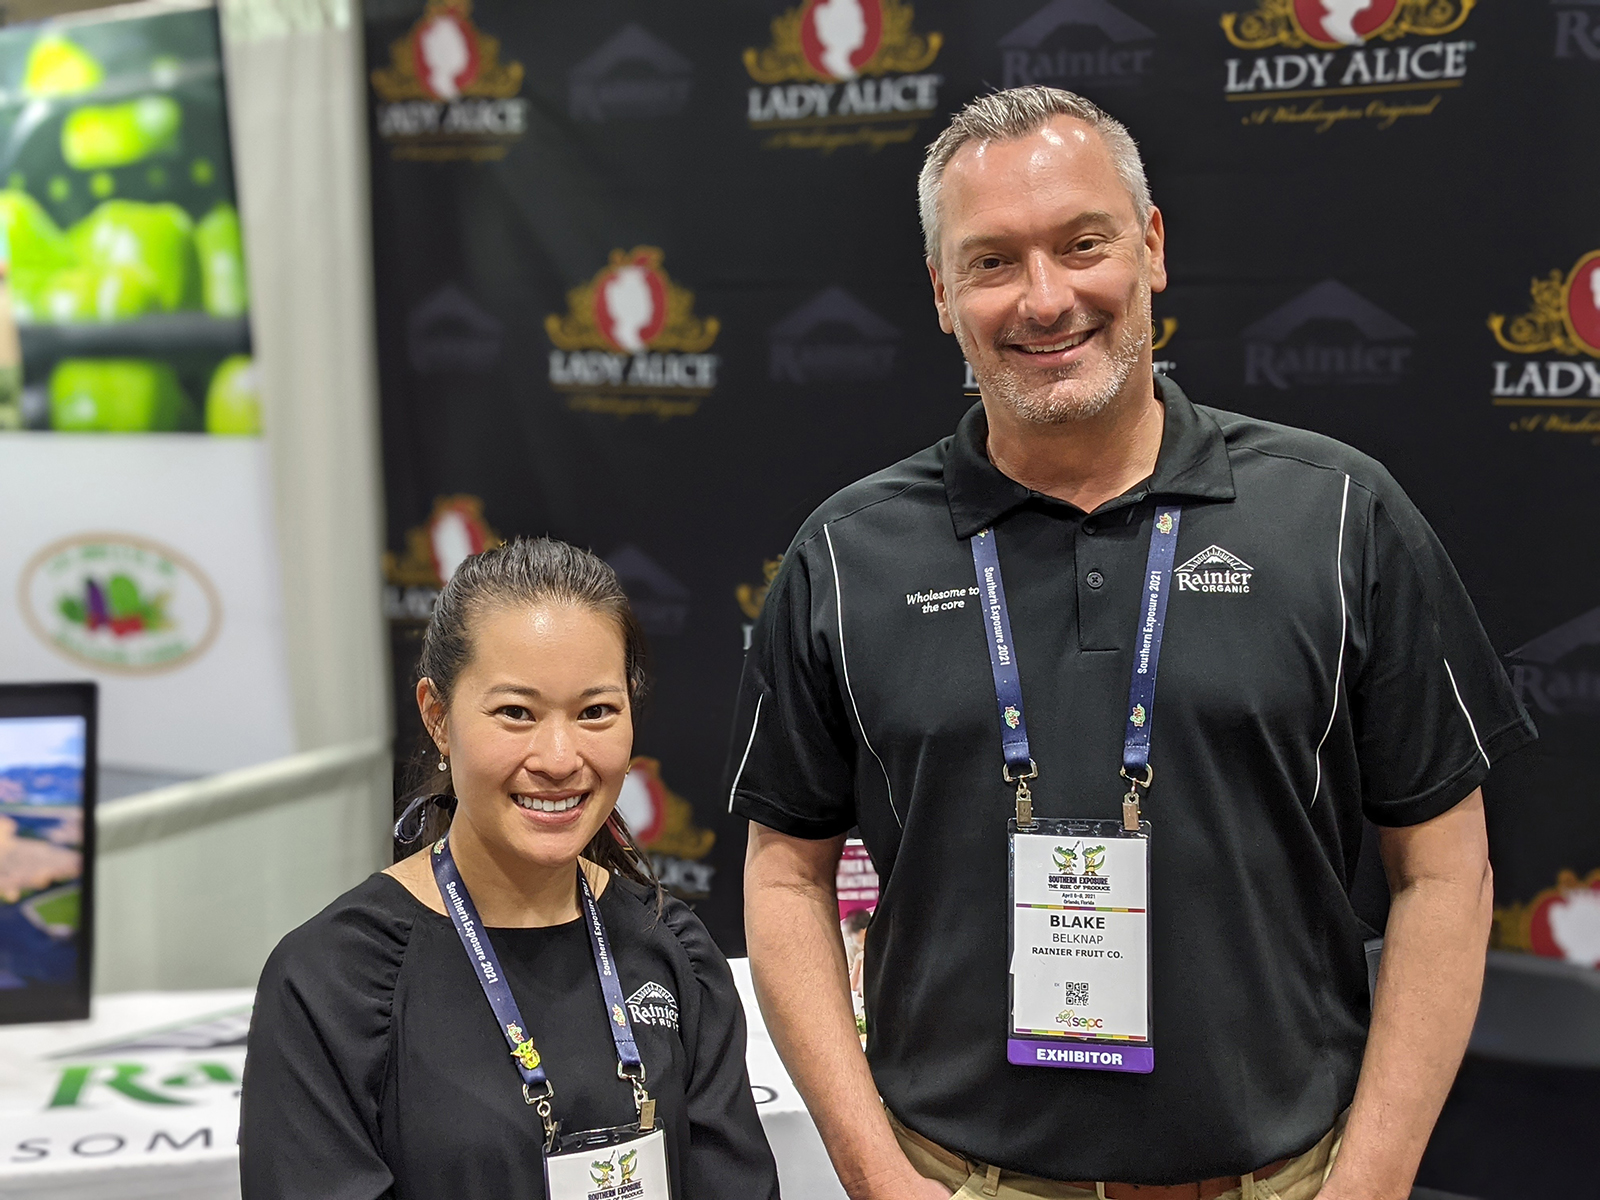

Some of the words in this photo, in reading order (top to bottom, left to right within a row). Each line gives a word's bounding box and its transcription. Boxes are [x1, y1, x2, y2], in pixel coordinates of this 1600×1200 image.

[1002, 46, 1153, 88] Rainier
[1225, 51, 1335, 93] LADY
[1340, 41, 1468, 84] ALICE
[748, 84, 835, 122] LADY
[838, 74, 939, 117] ALICE
[1245, 341, 1412, 390] Rainier
[1491, 361, 1600, 397] LADY
[984, 566, 998, 605] Southern
[1148, 570, 1162, 592] 2021
[1175, 569, 1252, 591] Rainier
[1201, 585, 1250, 593] ORGANIC
[906, 589, 967, 605] Wholesome
[968, 586, 980, 596] to
[921, 602, 940, 613] the
[941, 600, 965, 610] core
[990, 604, 1005, 644] Exposure
[1142, 593, 1159, 633] Exposure
[997, 644, 1011, 666] 2021
[1137, 633, 1153, 675] Southern
[1048, 875, 1077, 884] SOUTHERN
[1079, 877, 1109, 885] EXPOSURE
[587, 899, 603, 936] Exposure
[1050, 915, 1105, 929] BLAKE
[446, 881, 470, 922] Southern
[463, 920, 486, 961] Exposure
[481, 961, 498, 984] 2021
[1052, 933, 1103, 944] BELKNAP
[597, 937, 612, 976] Southern
[1032, 946, 1073, 956] RAINIER
[1075, 949, 1105, 958] FRUIT
[1106, 951, 1124, 959] CO.
[627, 1003, 679, 1025] Rainier
[651, 1017, 679, 1032] FRUIT
[1072, 1017, 1103, 1031] sepc
[1036, 1048, 1123, 1066] EXHIBITOR
